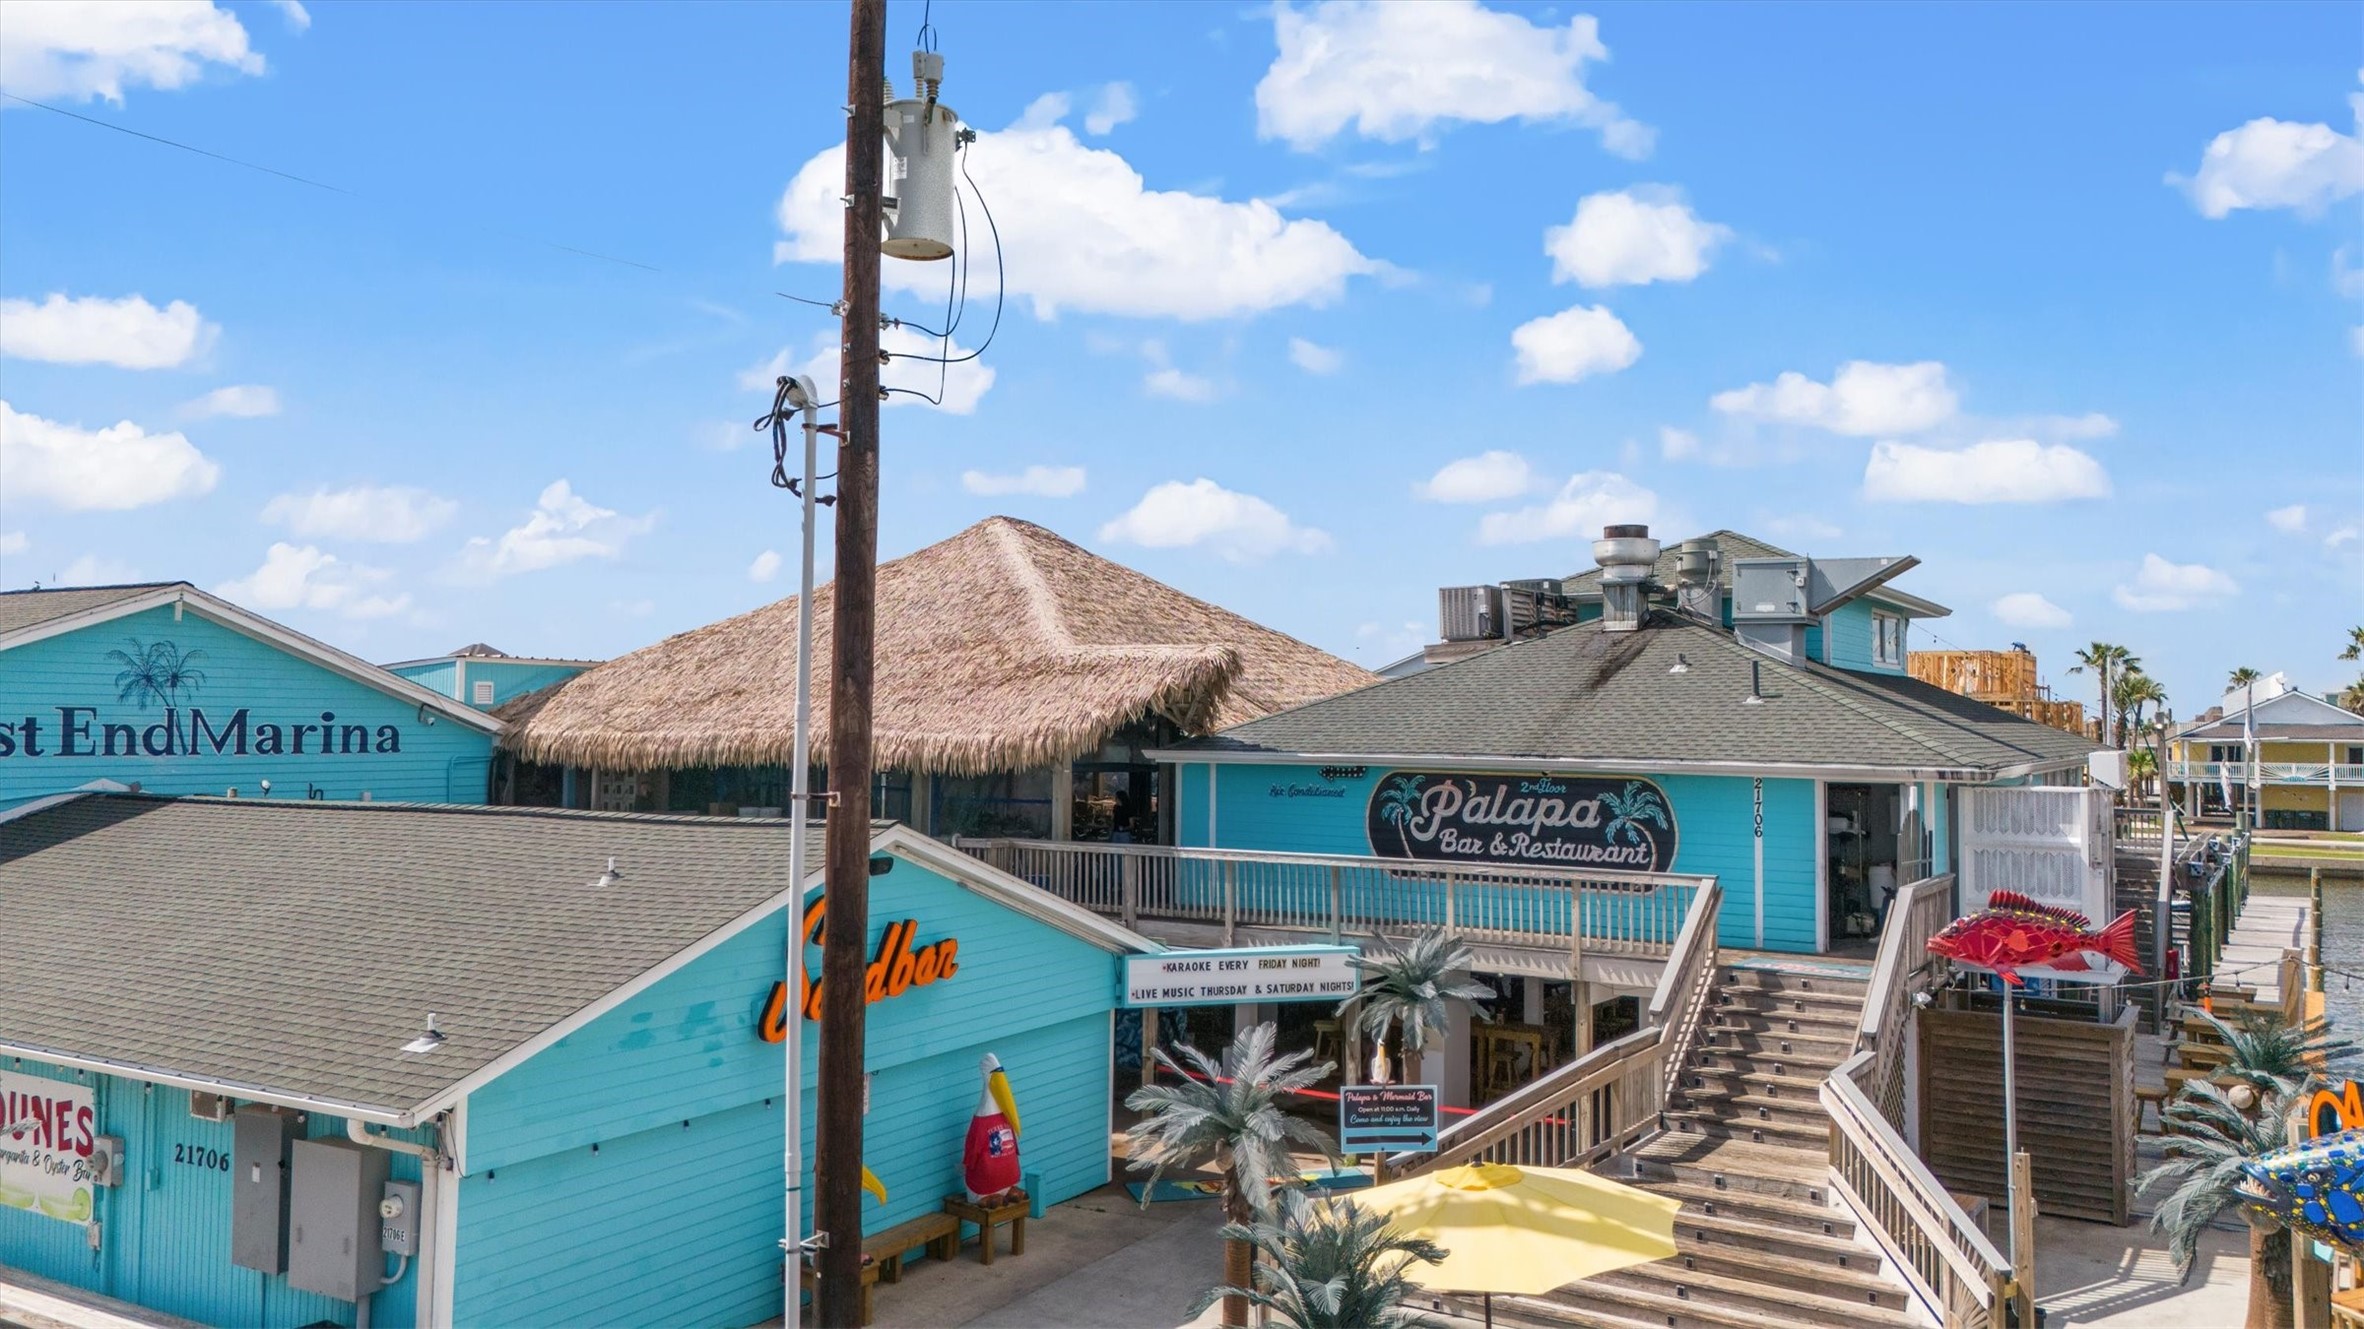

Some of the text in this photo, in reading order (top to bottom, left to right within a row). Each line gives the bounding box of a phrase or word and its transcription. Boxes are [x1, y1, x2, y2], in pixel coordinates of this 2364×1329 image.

[53, 706, 178, 758] End
[188, 707, 402, 756] Marina
[1539, 777, 1568, 794] Floor
[1409, 779, 1601, 842] Palapa
[1754, 777, 1763, 838] 21706
[1438, 828, 1485, 855] Bar
[1166, 957, 1321, 972] KARAOKE EVERY FRIDAY NIGHT!
[1134, 981, 1355, 1000] LIVE MUSIC THURSDAY & SATURDAY NIGHTS!
[1345, 1091, 1371, 1104] Palapa
[1380, 1090, 1416, 1101] Mermaid
[1416, 1090, 1433, 1102] Bar
[1350, 1113, 1370, 1124] Come
[1370, 1114, 1384, 1122] and
[1384, 1115, 1402, 1125] enjoy
[1402, 1113, 1412, 1122] the
[1406, 1105, 1421, 1113] Daily
[32, 1149, 41, 1167] &
[43, 1154, 71, 1176] Oyster
[175, 1143, 230, 1173] 21706
